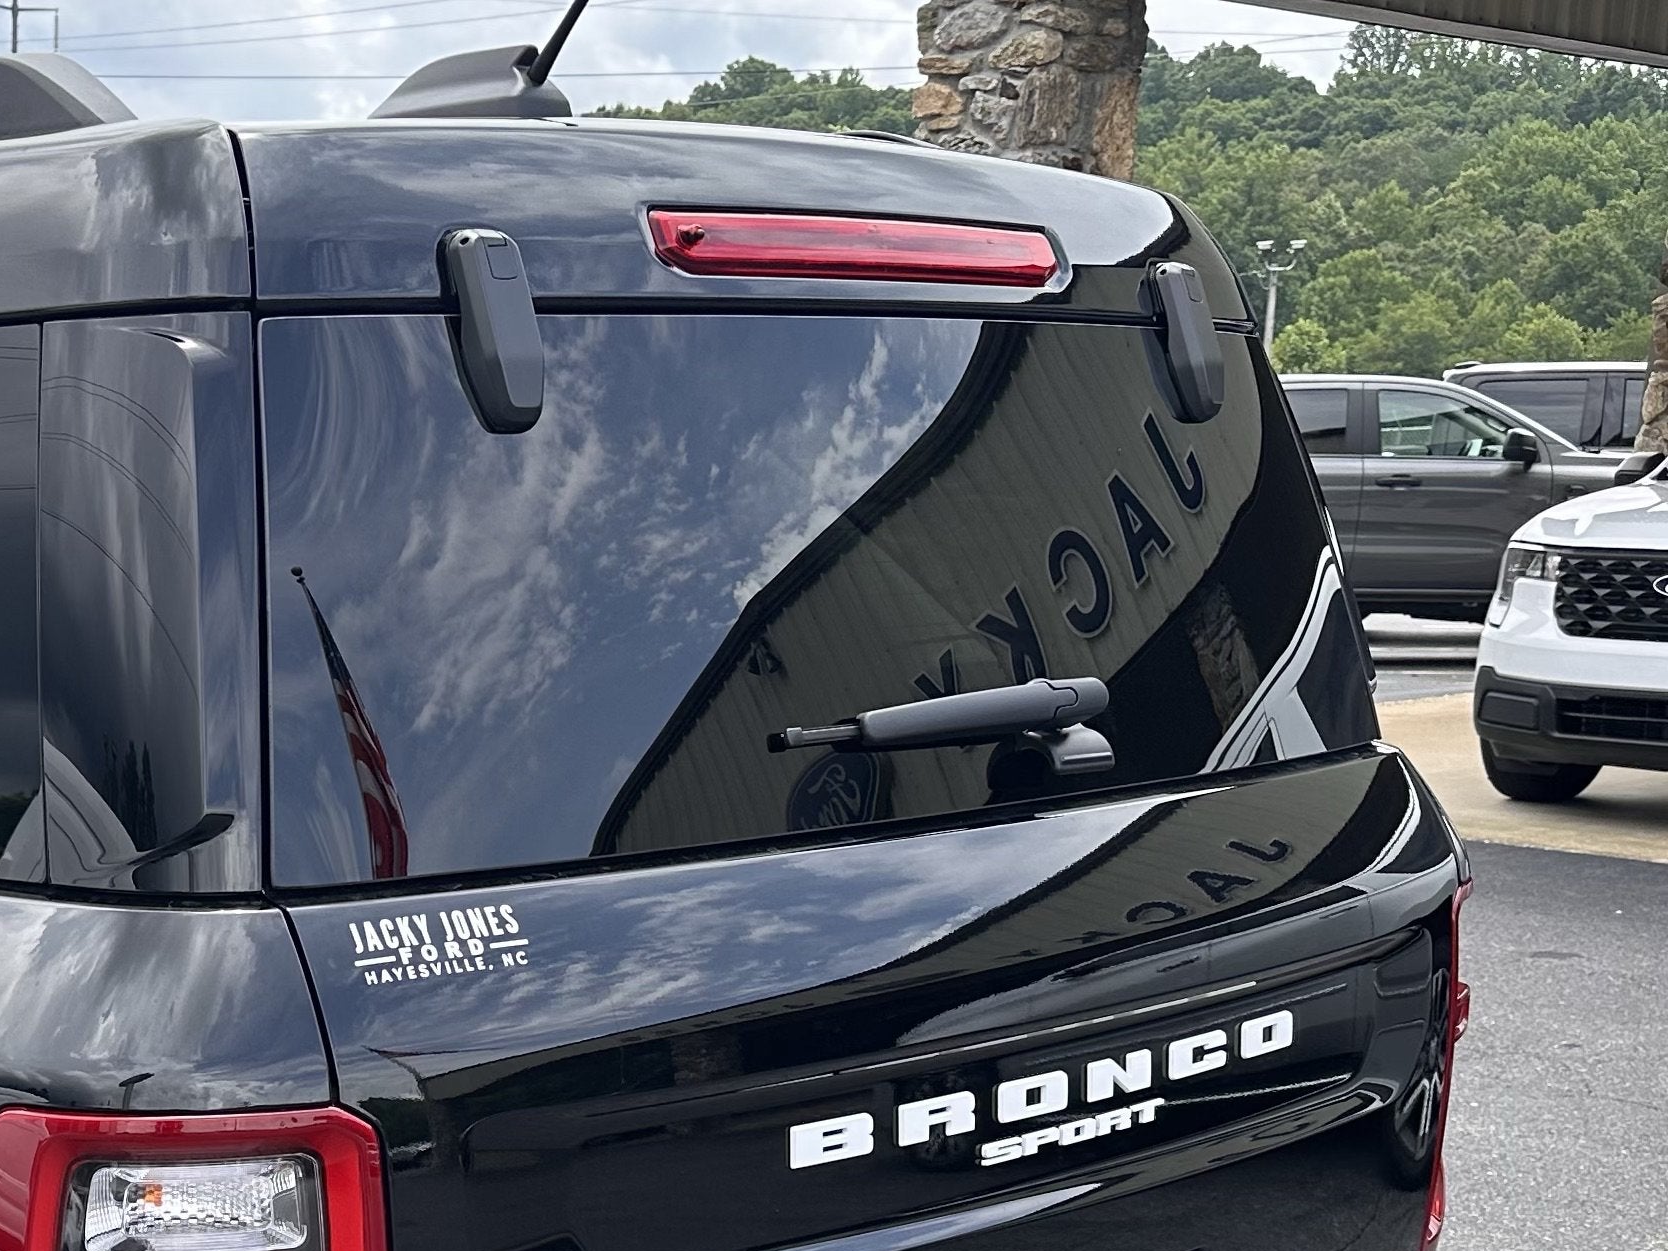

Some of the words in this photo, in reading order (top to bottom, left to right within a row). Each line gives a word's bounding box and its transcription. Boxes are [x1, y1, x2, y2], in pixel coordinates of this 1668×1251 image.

[348, 913, 434, 954] JACKY
[439, 904, 520, 942] JONES
[398, 938, 485, 966] FORD
[364, 956, 495, 986] HAYESVILLE,
[501, 950, 529, 968] NC
[787, 1009, 1294, 1170] BRONCO
[977, 1097, 1165, 1167] SPORT
